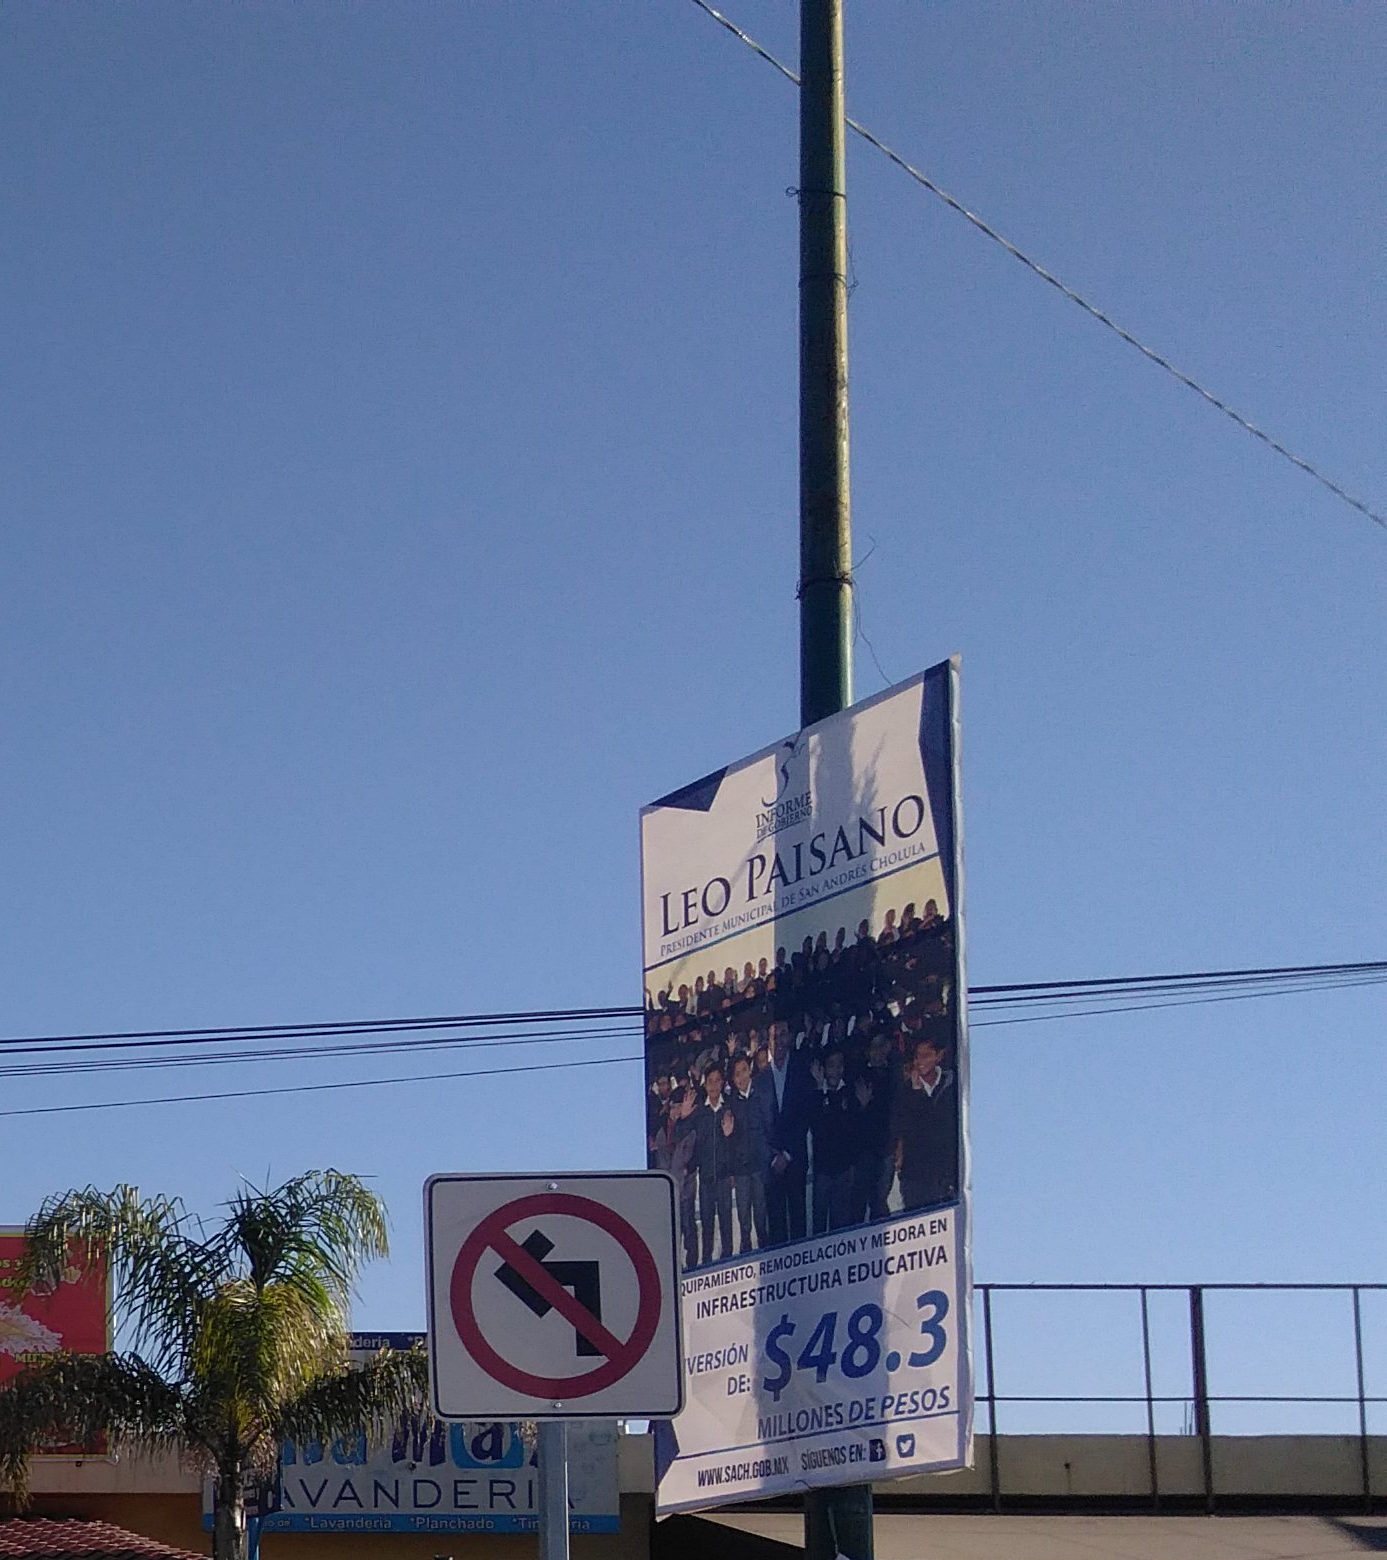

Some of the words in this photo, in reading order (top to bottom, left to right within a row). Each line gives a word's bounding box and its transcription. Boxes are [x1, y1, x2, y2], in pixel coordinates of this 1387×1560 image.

[755, 791, 812, 828] INFORME
[768, 805, 813, 833] GOBIERNO
[660, 877, 731, 938] LEO
[745, 794, 925, 903] PAISANO
[660, 924, 720, 957] PRESIDENTE
[722, 902, 779, 934] MUNICIPAL
[781, 892, 796, 908] DE
[799, 883, 820, 899] SAN
[822, 863, 868, 892] ANDRÉS
[870, 842, 926, 872] CHOLULA
[681, 1264, 757, 1297] QUIPAMIENTO,
[759, 1241, 856, 1276] REMODELACIÓN
[859, 1237, 867, 1251] Y
[871, 1223, 926, 1249] MEJORA
[930, 1217, 947, 1235] EN
[696, 1269, 842, 1319] INFRAESTRUCTURA
[847, 1245, 948, 1285] EDUCATIVA
[685, 1343, 749, 1375] VERSIÓN
[763, 1289, 950, 1402] $48.3
[727, 1374, 751, 1396] DE:
[758, 1402, 844, 1439] MILLONES
[849, 1398, 876, 1423] DE
[880, 1386, 950, 1418] PESOS
[697, 1456, 789, 1487] WWW.SACH.GOB.MX
[801, 1444, 847, 1471] SÍGUENOS
